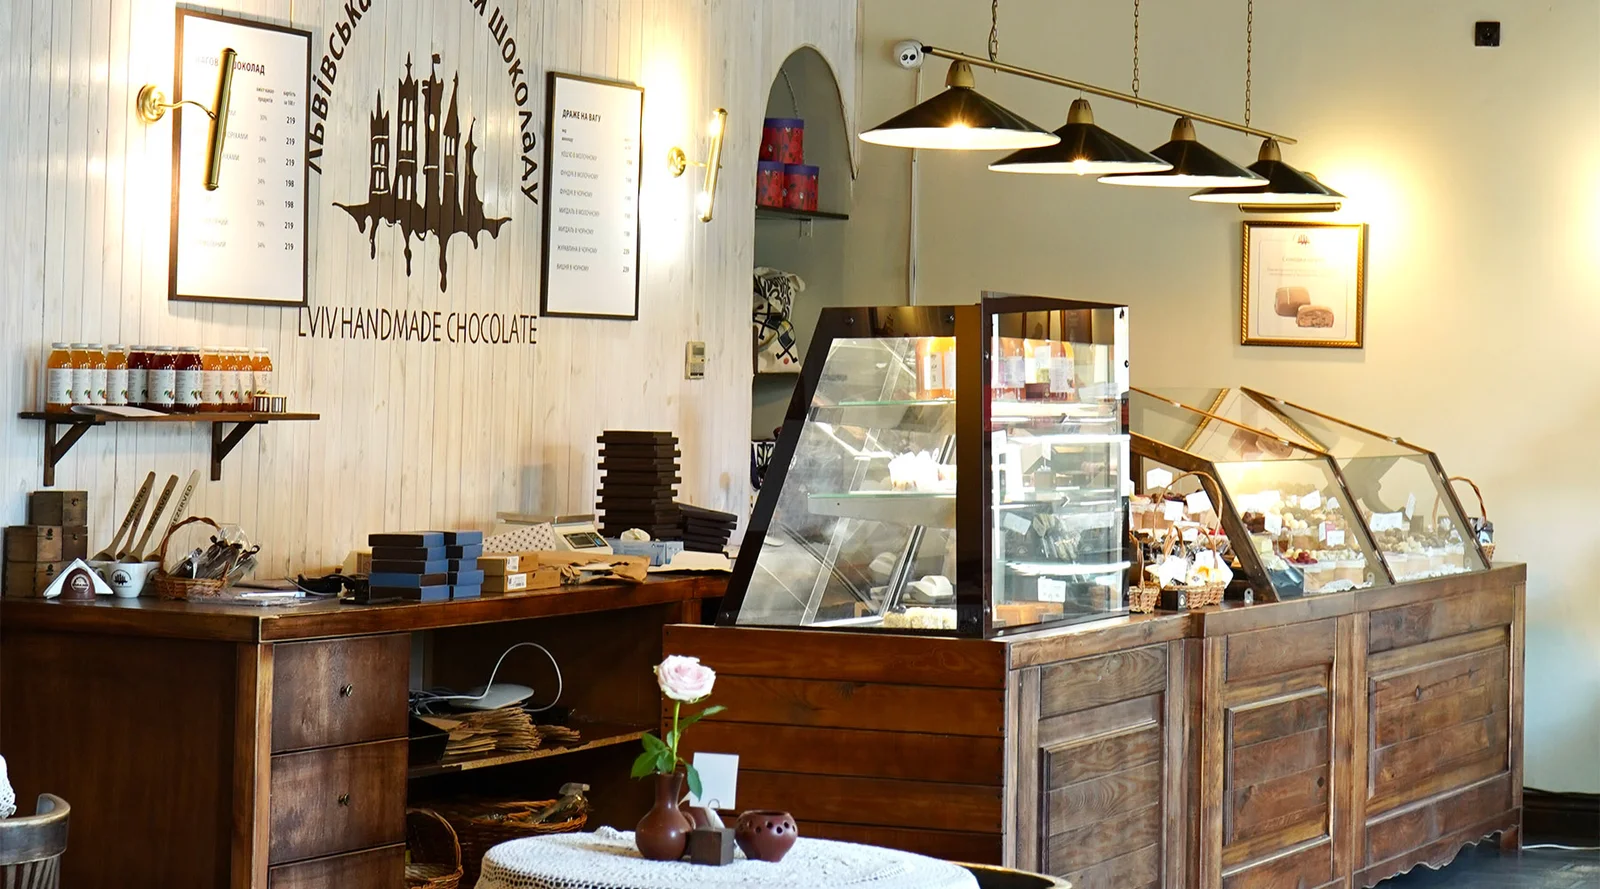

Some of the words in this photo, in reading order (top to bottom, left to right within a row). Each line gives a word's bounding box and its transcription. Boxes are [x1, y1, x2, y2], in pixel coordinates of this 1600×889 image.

[562, 109, 580, 120] ДРАЖЕ
[580, 111, 588, 120] НА
[588, 113, 601, 122] ВАГУ
[286, 116, 296, 125] 219
[285, 137, 295, 146] 219
[285, 158, 295, 167] 219
[285, 179, 295, 188] 198
[284, 200, 294, 209] 198
[284, 221, 294, 230] 219
[284, 242, 294, 251] 219
[298, 306, 338, 339] LVIV
[341, 307, 442, 343] HANDMADE
[446, 312, 538, 344] CHOCOLATE
[122, 486, 147, 528] REZERVED
[171, 484, 193, 526] REZERVED
